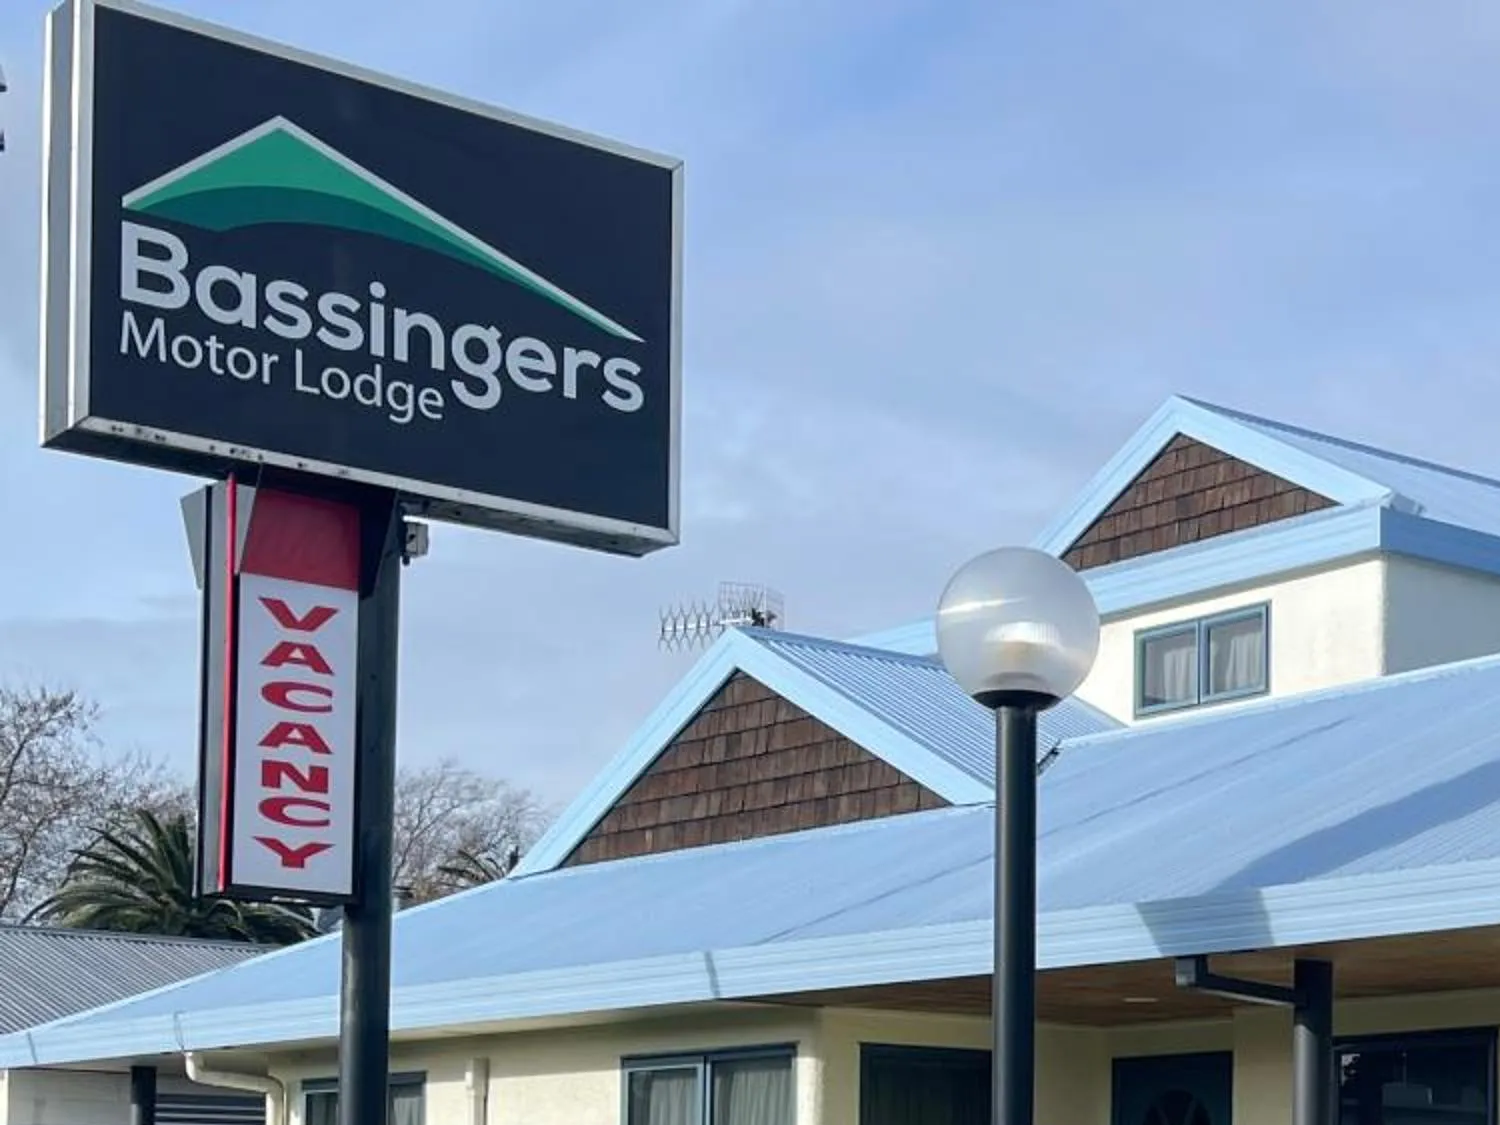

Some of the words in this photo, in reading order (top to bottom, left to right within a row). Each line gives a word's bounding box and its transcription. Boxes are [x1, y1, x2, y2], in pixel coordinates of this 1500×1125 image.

[119, 310, 279, 385] Motor
[295, 348, 445, 424] Lodge
[120, 220, 645, 412] Bassingers
[252, 596, 339, 869] VACANCY
